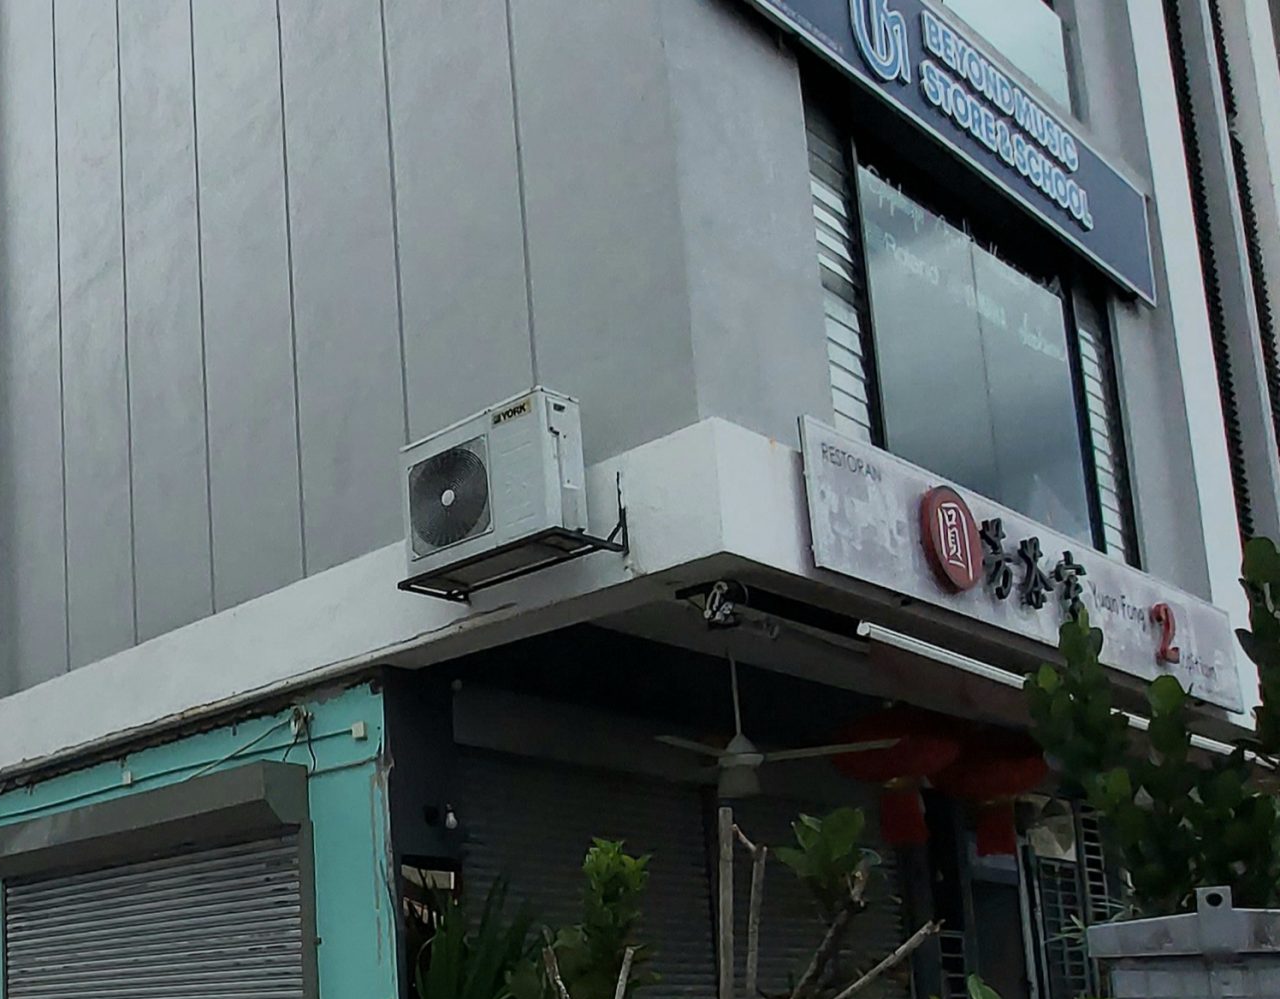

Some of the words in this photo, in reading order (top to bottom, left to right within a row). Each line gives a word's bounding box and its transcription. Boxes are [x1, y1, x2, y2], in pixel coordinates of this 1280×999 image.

[922, 10, 1015, 116] BEYOND
[1014, 88, 1079, 172] MUSIC
[920, 59, 998, 152] STORE
[995, 120, 1015, 167] &
[1011, 133, 1094, 230] SCHOOL
[501, 403, 526, 420] YORK
[821, 442, 882, 482] RESTORAN
[1150, 602, 1180, 667] 2
